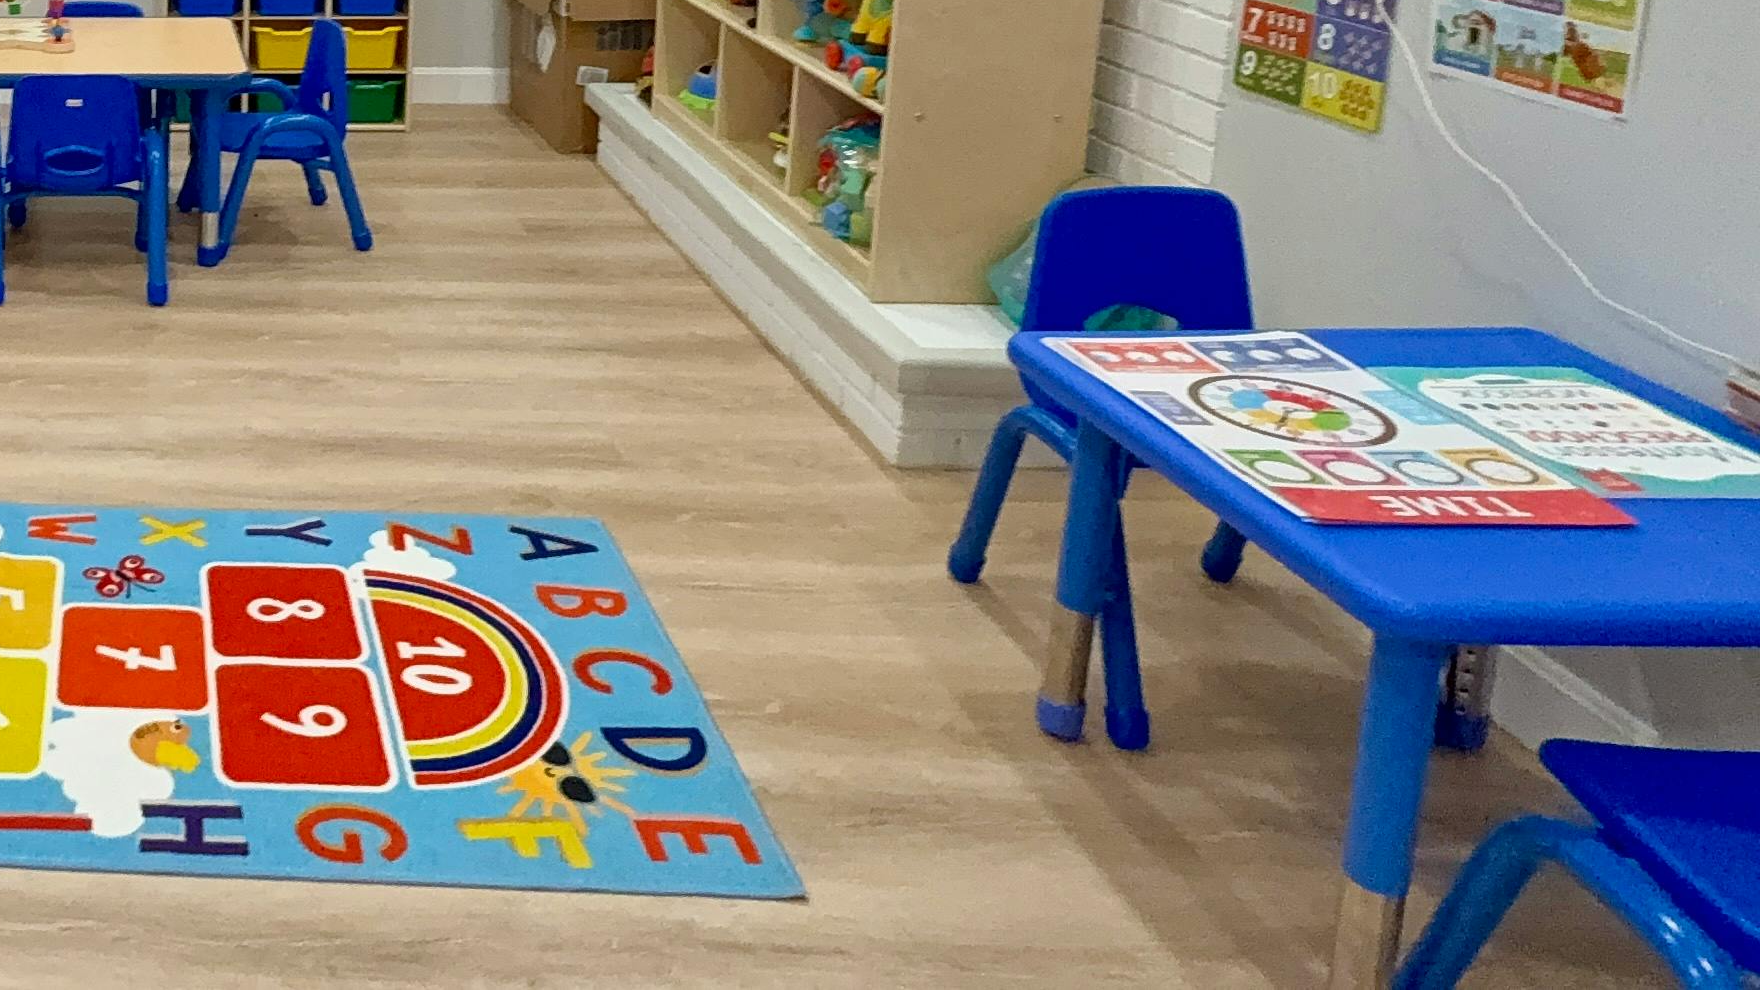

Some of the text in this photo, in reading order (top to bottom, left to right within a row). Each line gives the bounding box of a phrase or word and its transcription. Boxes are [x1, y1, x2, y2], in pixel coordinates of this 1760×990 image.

[1248, 7, 1265, 33] 7
[1317, 23, 1337, 50] 8
[1240, 50, 1257, 76] 9
[1310, 71, 1338, 99] 10
[1510, 429, 1712, 443] PRESCHOOL
[1368, 494, 1535, 518] TIME
[27, 514, 97, 547] W
[140, 515, 208, 549] X
[245, 516, 333, 547] Y
[387, 521, 473, 556] Z
[508, 525, 599, 561] A
[247, 597, 325, 622] 8
[533, 583, 628, 618] B
[95, 644, 177, 671] 7
[396, 636, 473, 695] 10
[572, 647, 673, 695] C
[259, 704, 347, 738] 9
[600, 727, 708, 777] D
[139, 798, 250, 856] H
[295, 802, 408, 864] G
[457, 817, 593, 869] F
[633, 814, 762, 865] E
